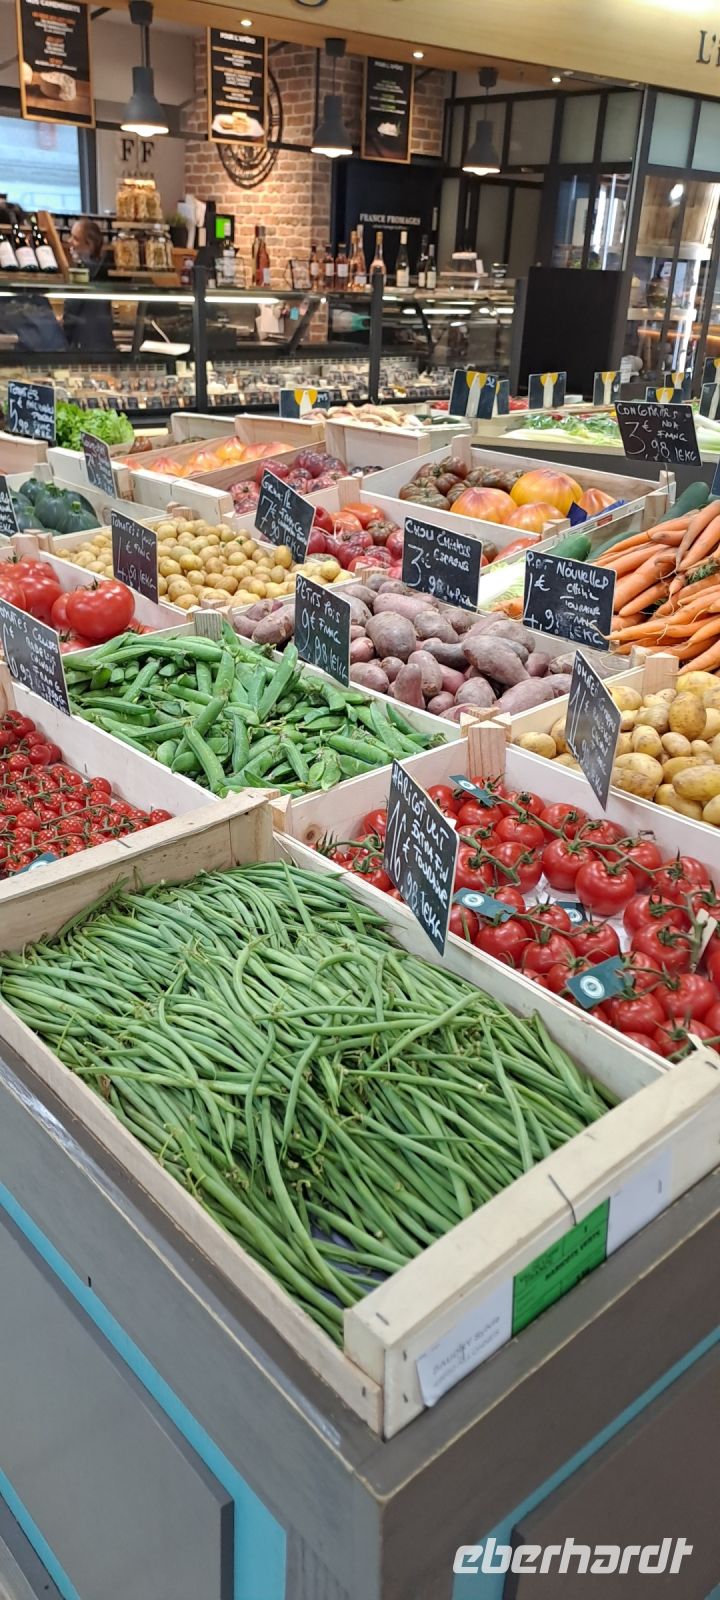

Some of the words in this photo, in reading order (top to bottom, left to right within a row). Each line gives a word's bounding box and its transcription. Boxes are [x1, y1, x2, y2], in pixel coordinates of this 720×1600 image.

[360, 213, 386, 224] FRANCE
[387, 215, 420, 226] FROMAGES
[405, 519, 434, 541] CHOU
